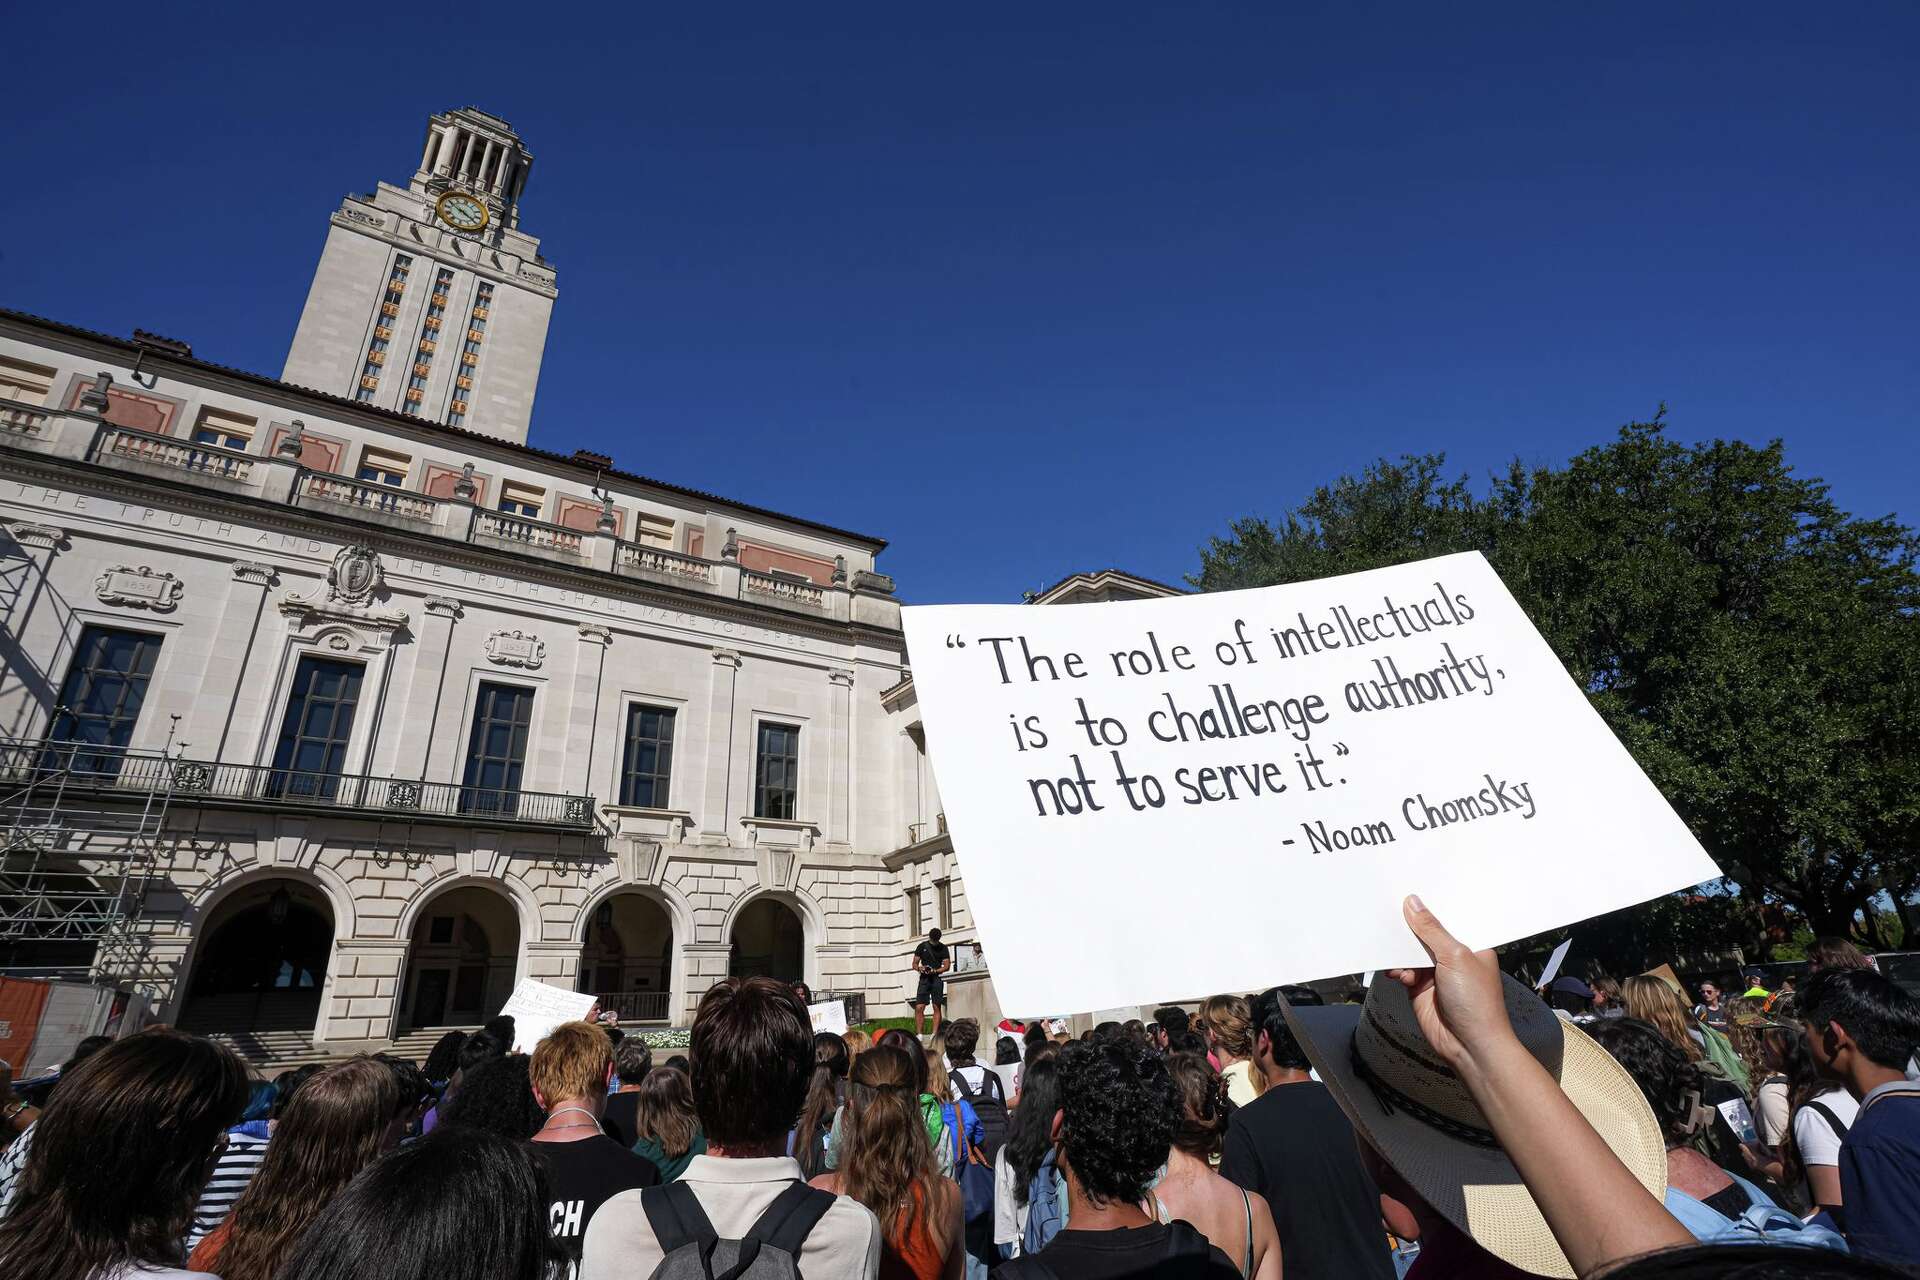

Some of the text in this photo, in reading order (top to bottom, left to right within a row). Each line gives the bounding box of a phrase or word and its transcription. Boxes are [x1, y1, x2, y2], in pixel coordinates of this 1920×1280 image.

[16, 483, 89, 509] THE
[119, 503, 233, 537] TRUTH
[256, 532, 322, 553] AND
[394, 557, 441, 577] THE
[462, 570, 539, 595] TRUTH
[559, 591, 626, 613] SHALL
[641, 605, 696, 626] MAKE
[711, 618, 748, 636] YOU
[1110, 632, 1195, 676] role
[1216, 619, 1258, 665] of
[1270, 582, 1475, 658] intellectuals
[1010, 643, 1506, 751] is to challenge authority,
[1027, 754, 1104, 816] not
[1110, 751, 1166, 811] to
[1175, 763, 1287, 804] serve
[1402, 774, 1536, 830] Chomsky
